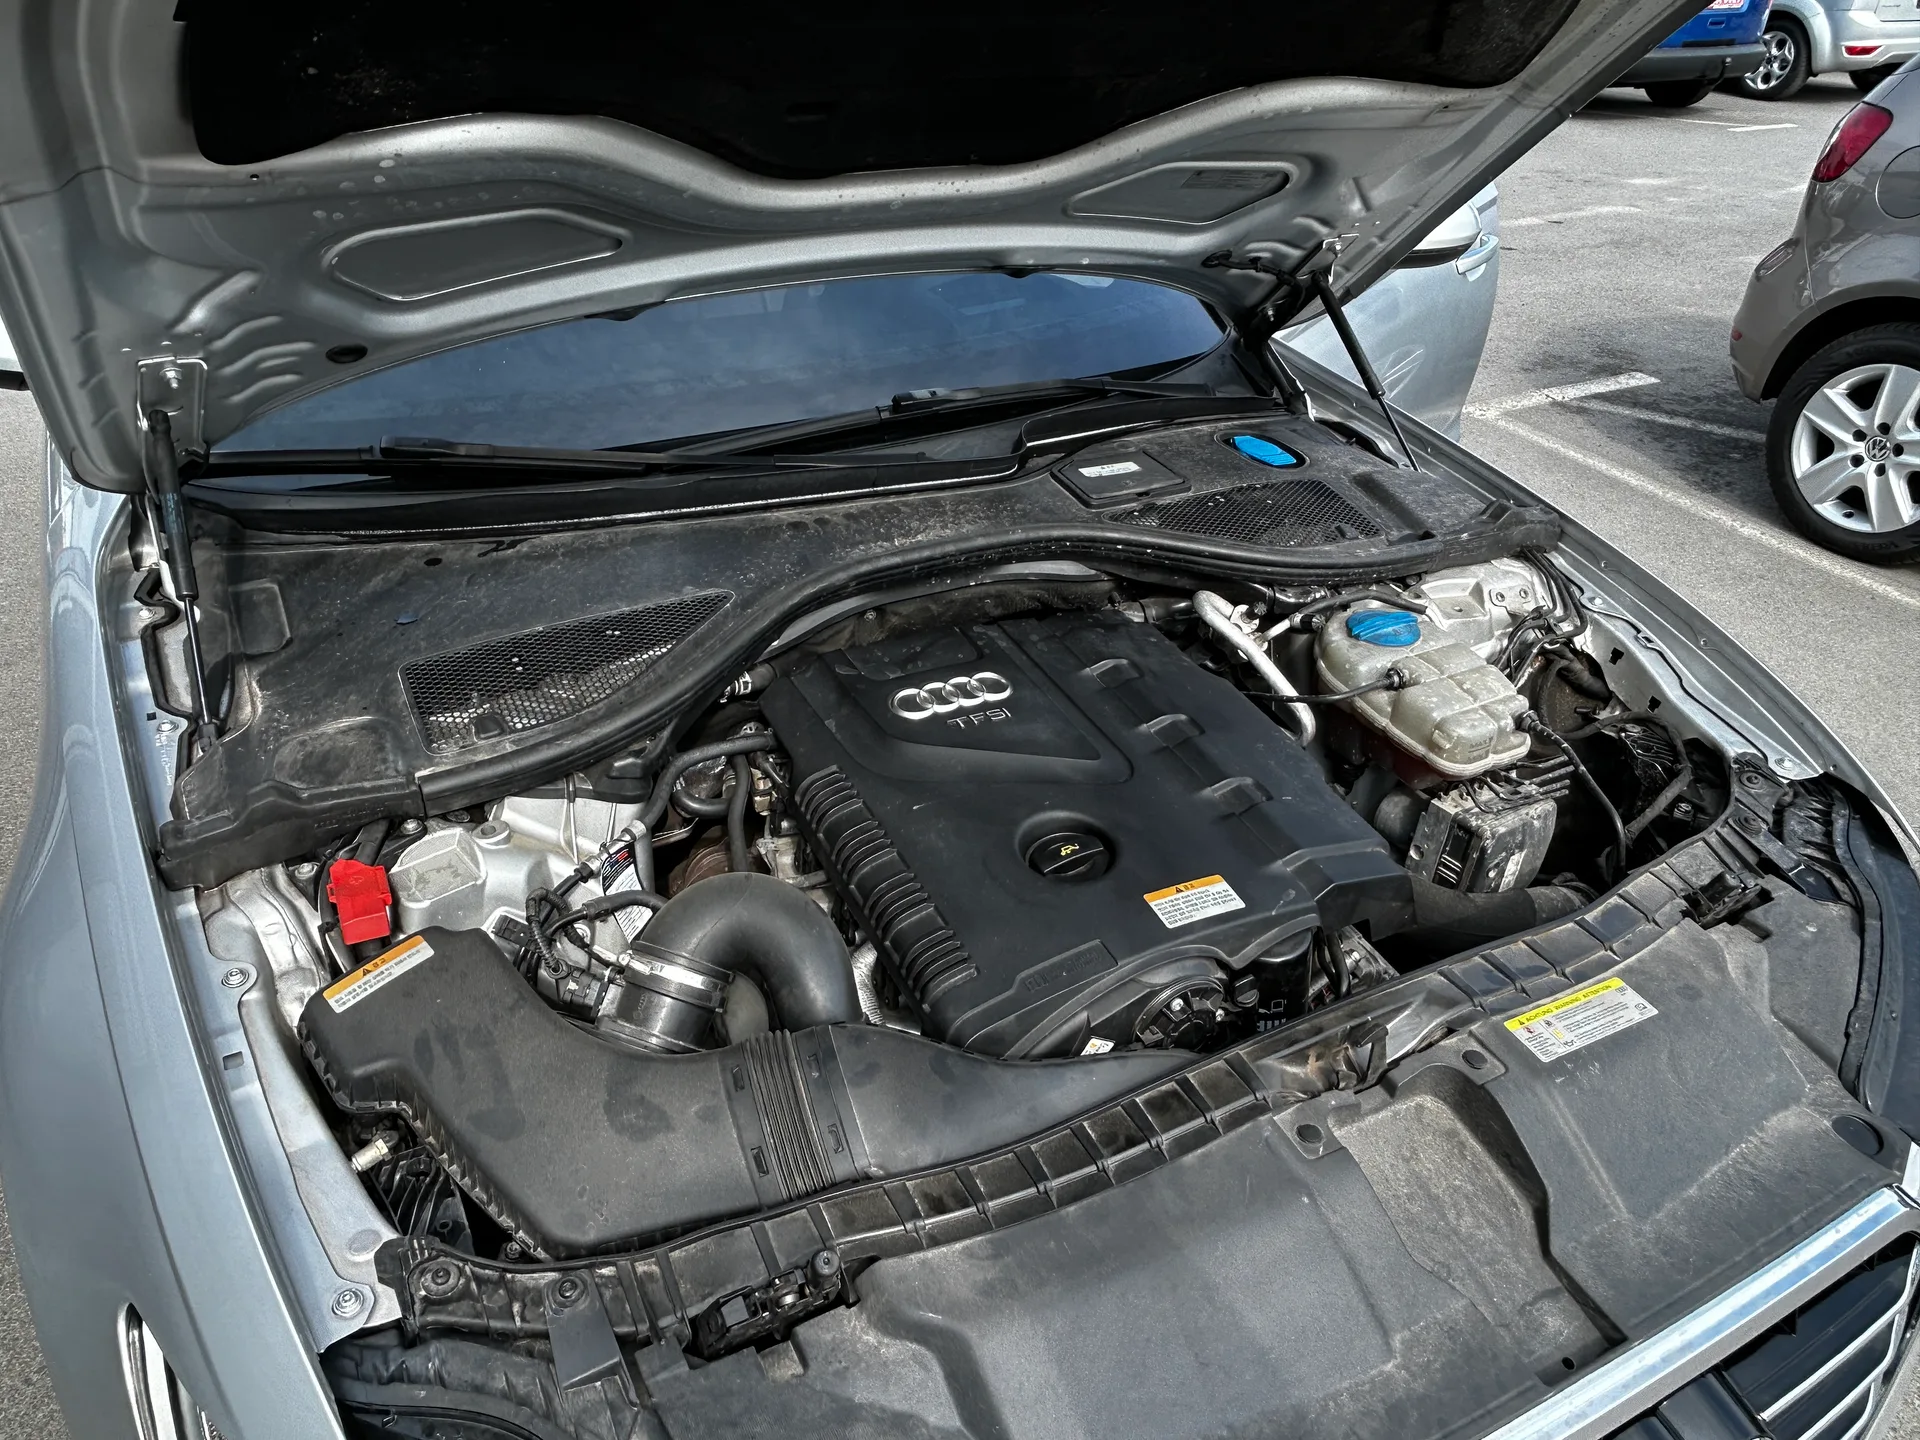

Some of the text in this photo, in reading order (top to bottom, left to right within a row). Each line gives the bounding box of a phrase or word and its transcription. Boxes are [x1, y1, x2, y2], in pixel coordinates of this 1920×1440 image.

[947, 707, 1011, 729] TFSI
[1526, 1008, 1553, 1022] ACHTUNG
[1555, 996, 1581, 1010] WARNING
[1582, 985, 1612, 999] ATTENTION
